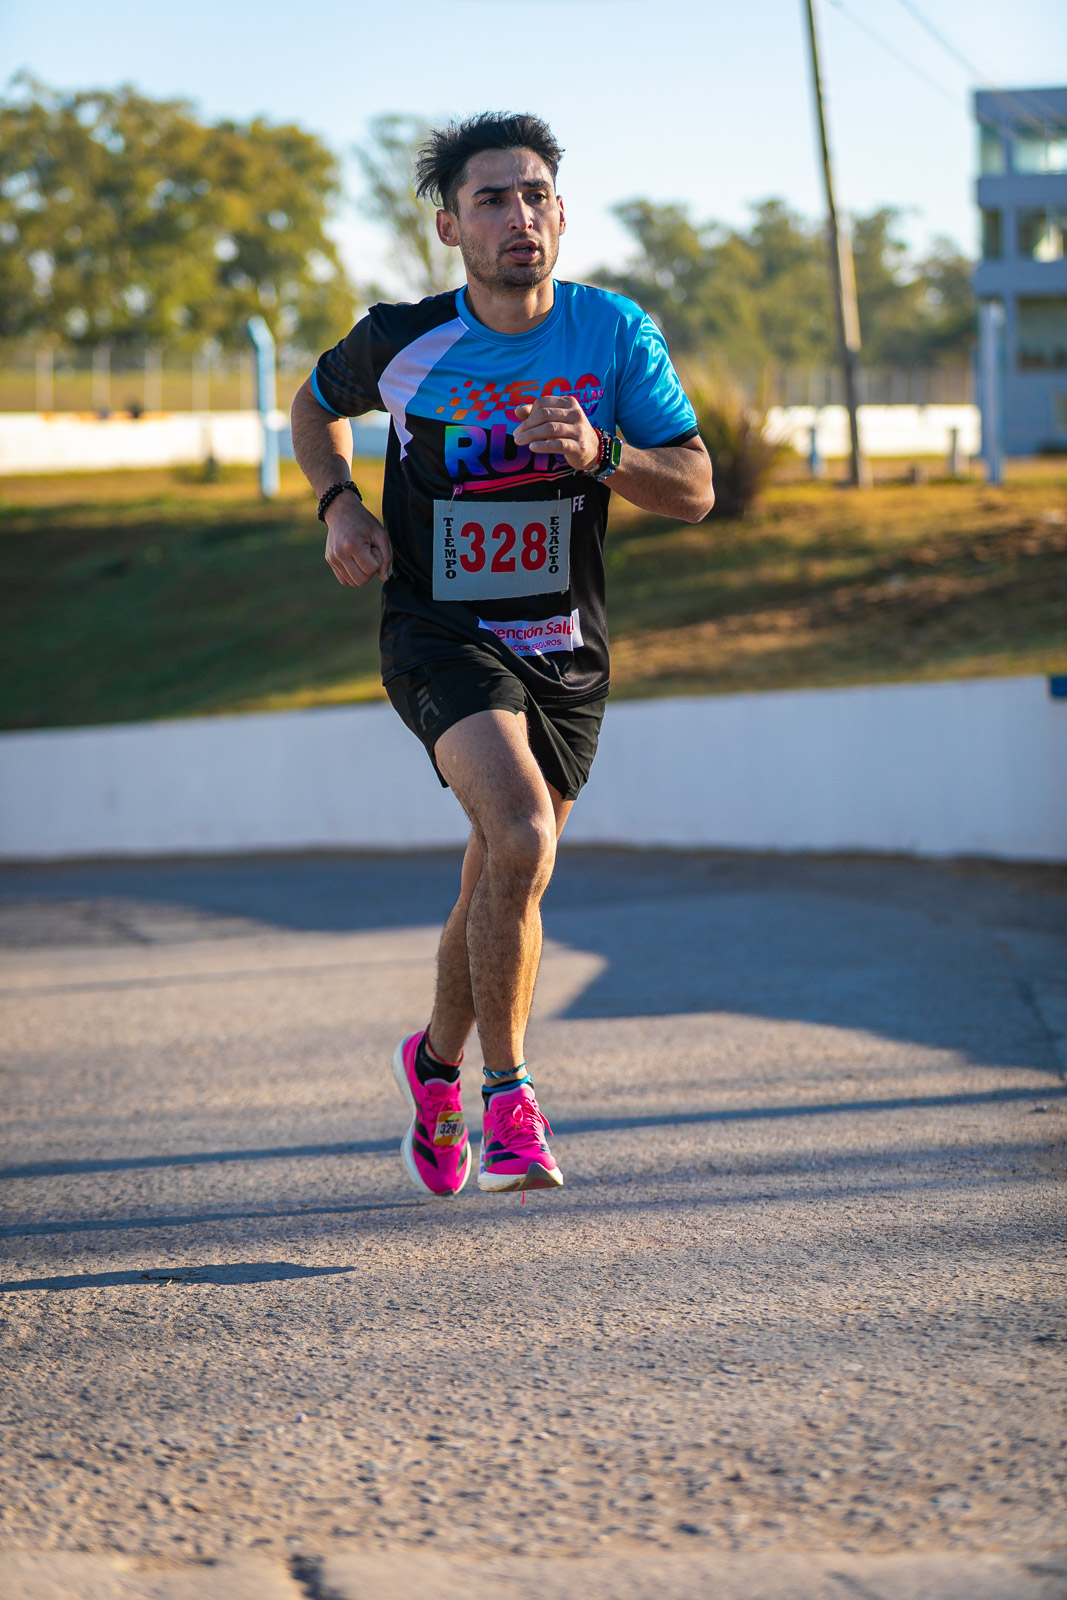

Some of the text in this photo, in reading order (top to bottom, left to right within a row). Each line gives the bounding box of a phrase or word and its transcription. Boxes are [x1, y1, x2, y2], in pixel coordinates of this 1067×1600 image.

[560, 389, 604, 403] ILLAS
[443, 517, 457, 579] TIEMPO
[459, 521, 548, 573] 328
[548, 516, 560, 574] EXACTO
[511, 639, 562, 652] COR SEGUROS
